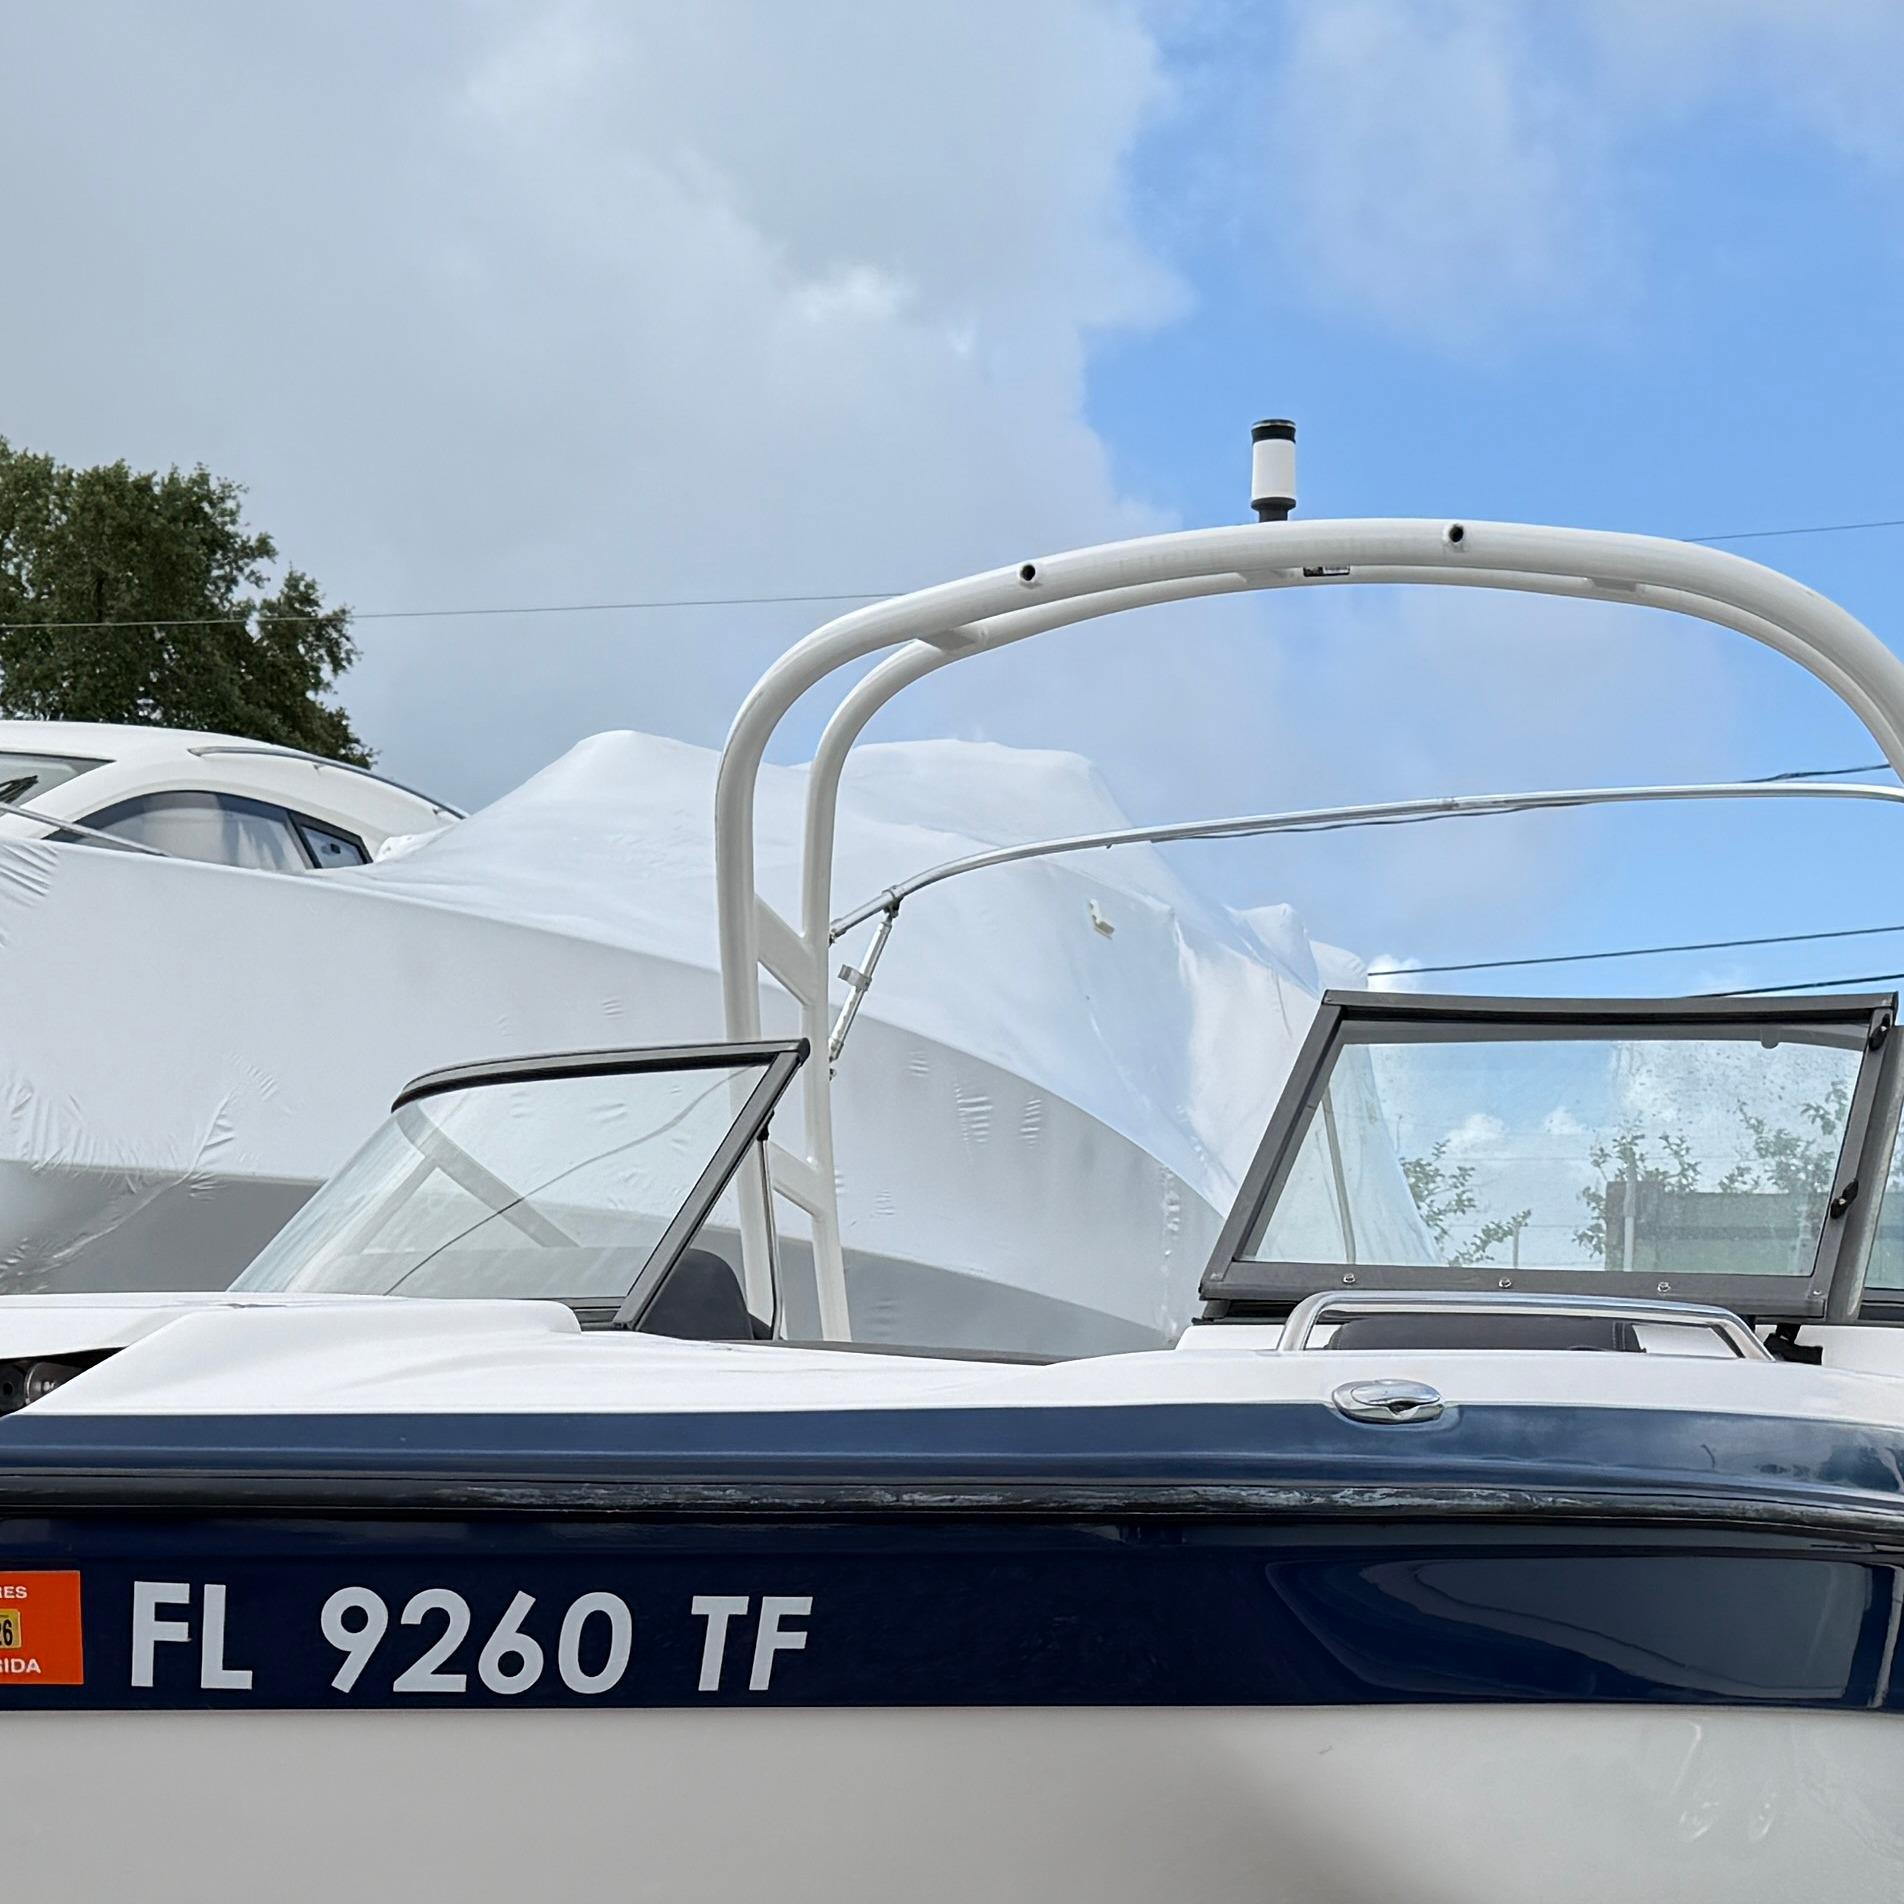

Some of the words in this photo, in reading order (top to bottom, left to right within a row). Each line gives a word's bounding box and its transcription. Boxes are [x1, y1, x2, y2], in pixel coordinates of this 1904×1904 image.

[130, 1580, 253, 1690] FL
[320, 1585, 633, 1695] 9260
[690, 1594, 813, 1693] TF
